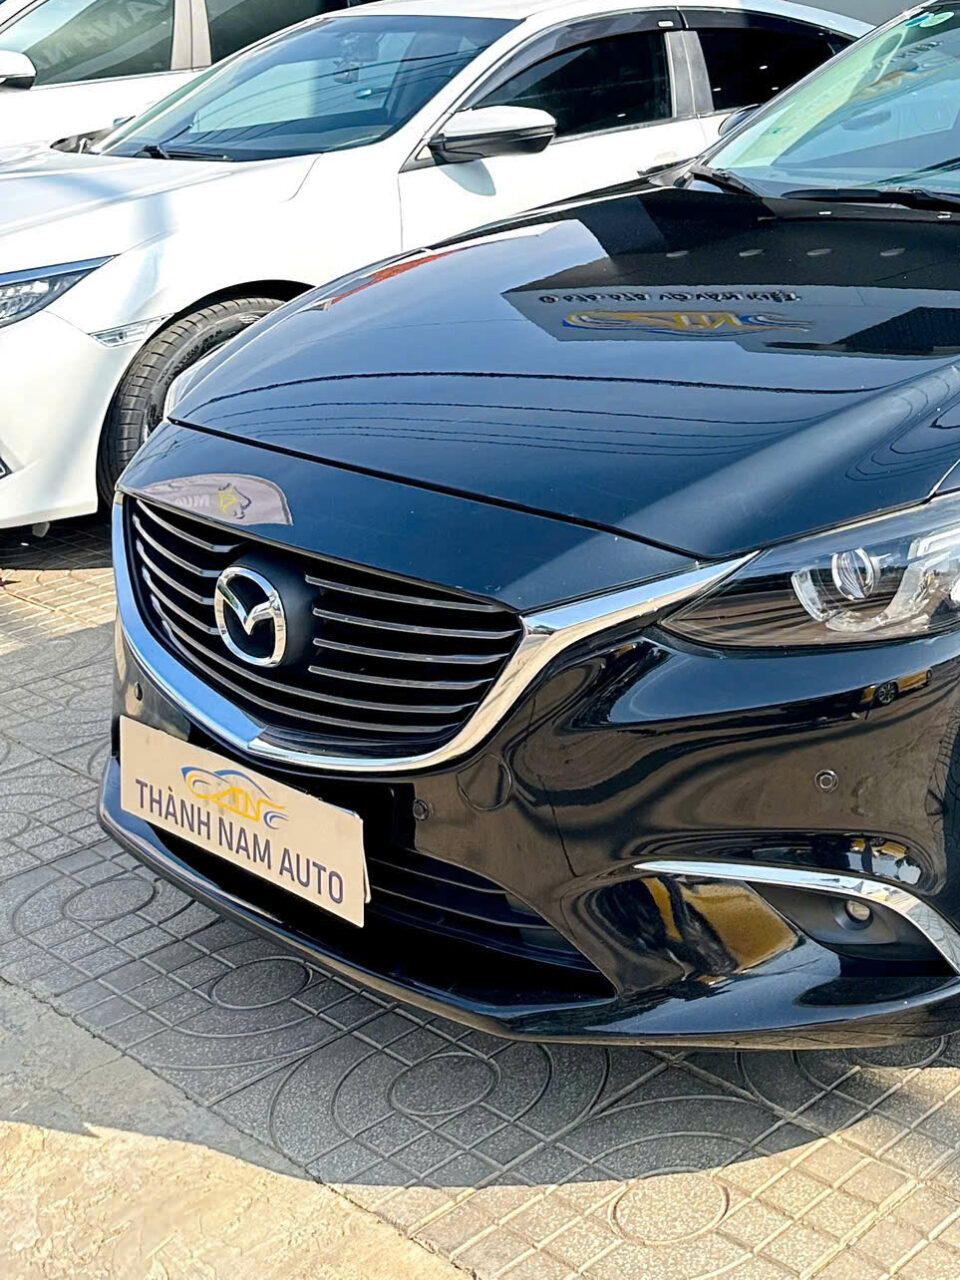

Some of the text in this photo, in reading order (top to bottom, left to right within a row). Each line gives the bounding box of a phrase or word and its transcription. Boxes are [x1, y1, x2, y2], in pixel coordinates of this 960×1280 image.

[135, 778, 344, 905] THÀNH NAM AUTO
